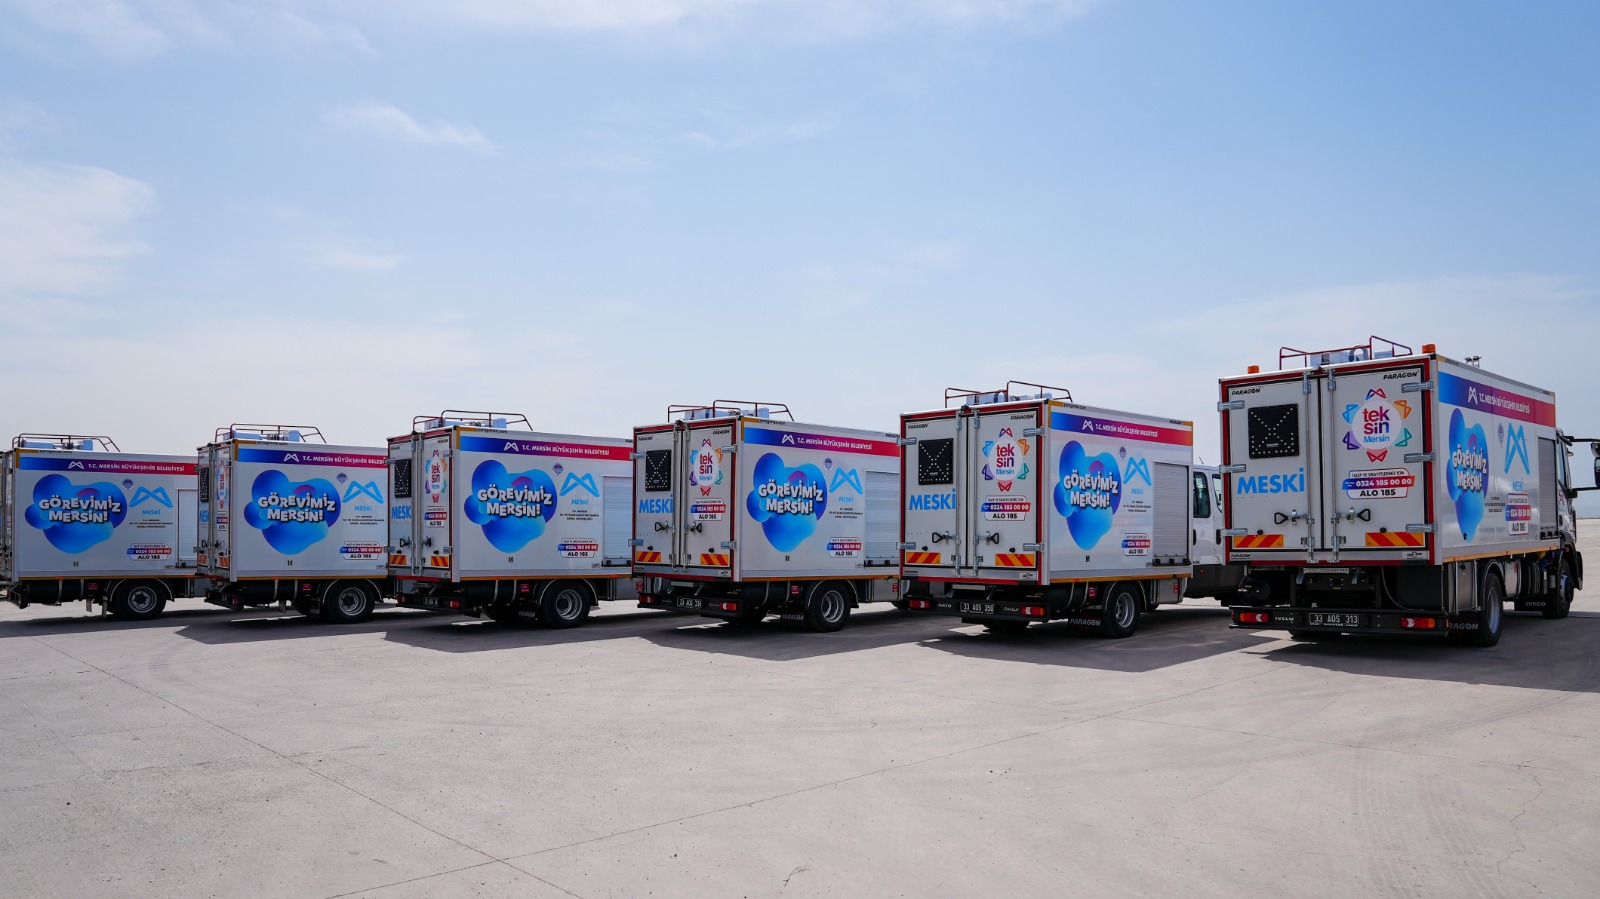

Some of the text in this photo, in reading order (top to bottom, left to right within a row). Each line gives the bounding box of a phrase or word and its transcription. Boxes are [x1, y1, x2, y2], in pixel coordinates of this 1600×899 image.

[1363, 406, 1390, 422] tek
[1363, 421, 1389, 435] sin
[824, 440, 850, 448] BÜYÜKŞEHİR
[1363, 435, 1389, 443] Mersin
[552, 446, 584, 454] BÜYÜKŞEHİR
[996, 443, 1015, 457] tek
[700, 452, 713, 464] tek
[996, 456, 1014, 468] sin
[1452, 444, 1486, 474] GÖREVİMİZ
[700, 464, 713, 474] sin
[1064, 470, 1118, 493] GÖREVİMİZ
[1237, 467, 1304, 494] MESKİ
[1456, 470, 1482, 491] MERSİN!
[478, 484, 552, 504] GÖREVİMİZ
[758, 479, 823, 502] GÖREVİMİZ
[39, 495, 120, 512] GÖREVİMİZ
[258, 492, 336, 511] GÖREVİMİZ
[639, 494, 674, 513] MESKİ
[766, 499, 813, 514] MERSİN!
[909, 488, 956, 510] MESKİ
[1070, 491, 1110, 508] MERSİN!
[49, 510, 108, 522] MERSİN!
[268, 509, 324, 522] MERSİN!
[392, 506, 411, 519] MESK
[487, 502, 541, 517] MERSİN!
[1346, 615, 1358, 623] 313
